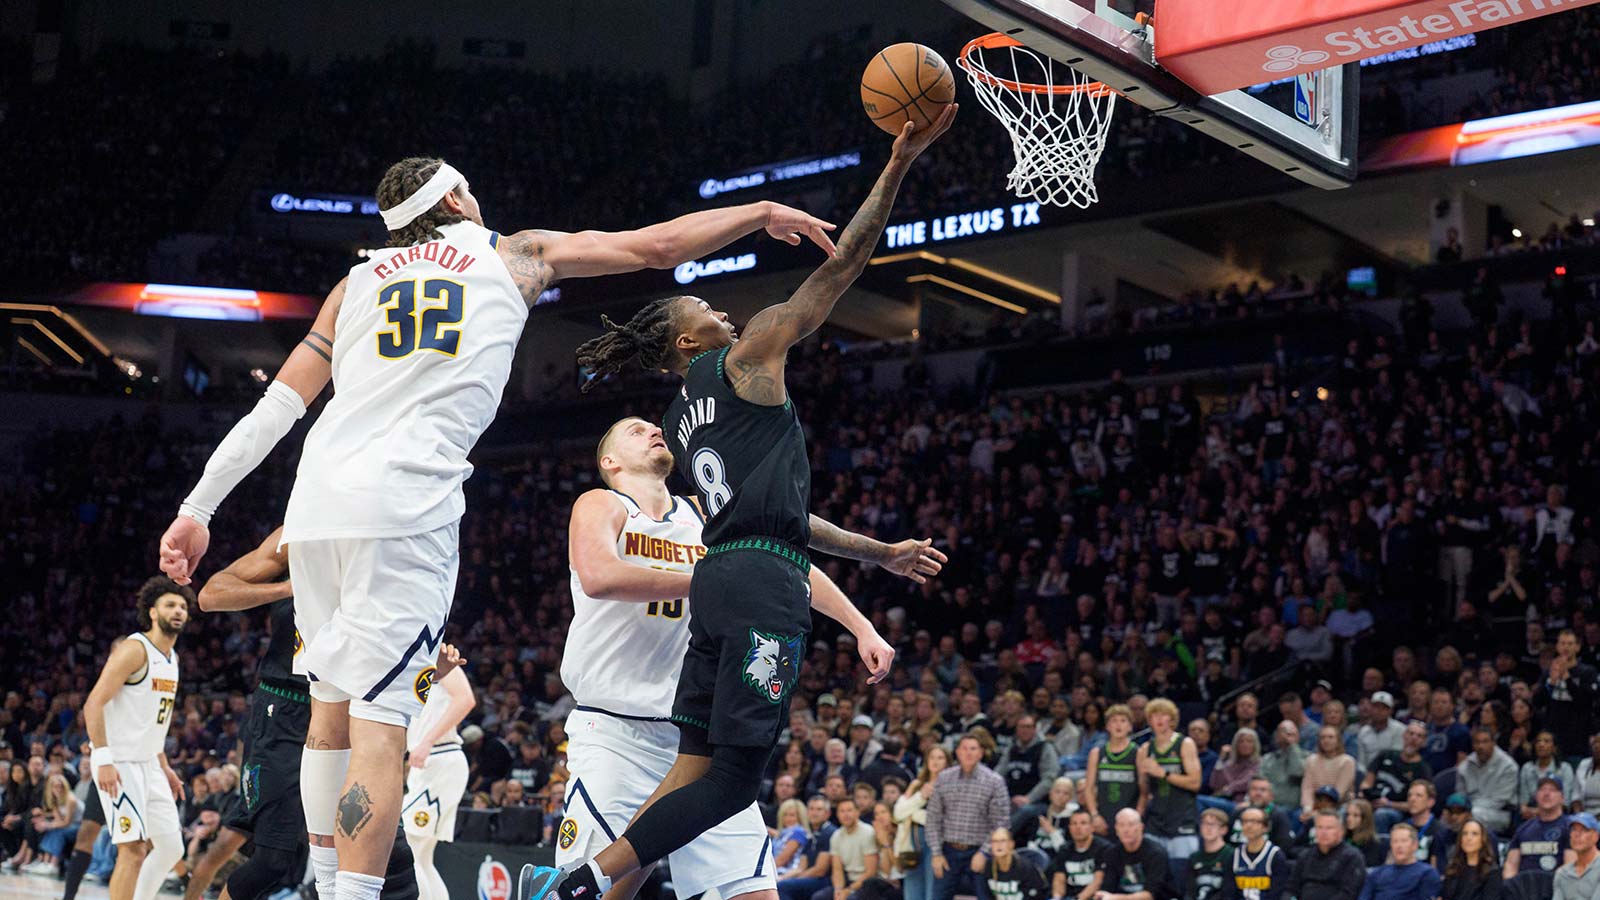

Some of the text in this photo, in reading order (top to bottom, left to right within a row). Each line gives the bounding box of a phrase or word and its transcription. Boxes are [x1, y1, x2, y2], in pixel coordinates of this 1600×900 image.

[885, 201, 1041, 248] THE LEXUS TX
[374, 242, 476, 280] GORDON
[375, 277, 467, 361] 32
[678, 396, 716, 451] HYLAND
[692, 447, 734, 518] 8
[624, 531, 707, 565] NUGGETS
[157, 697, 175, 724] 27
